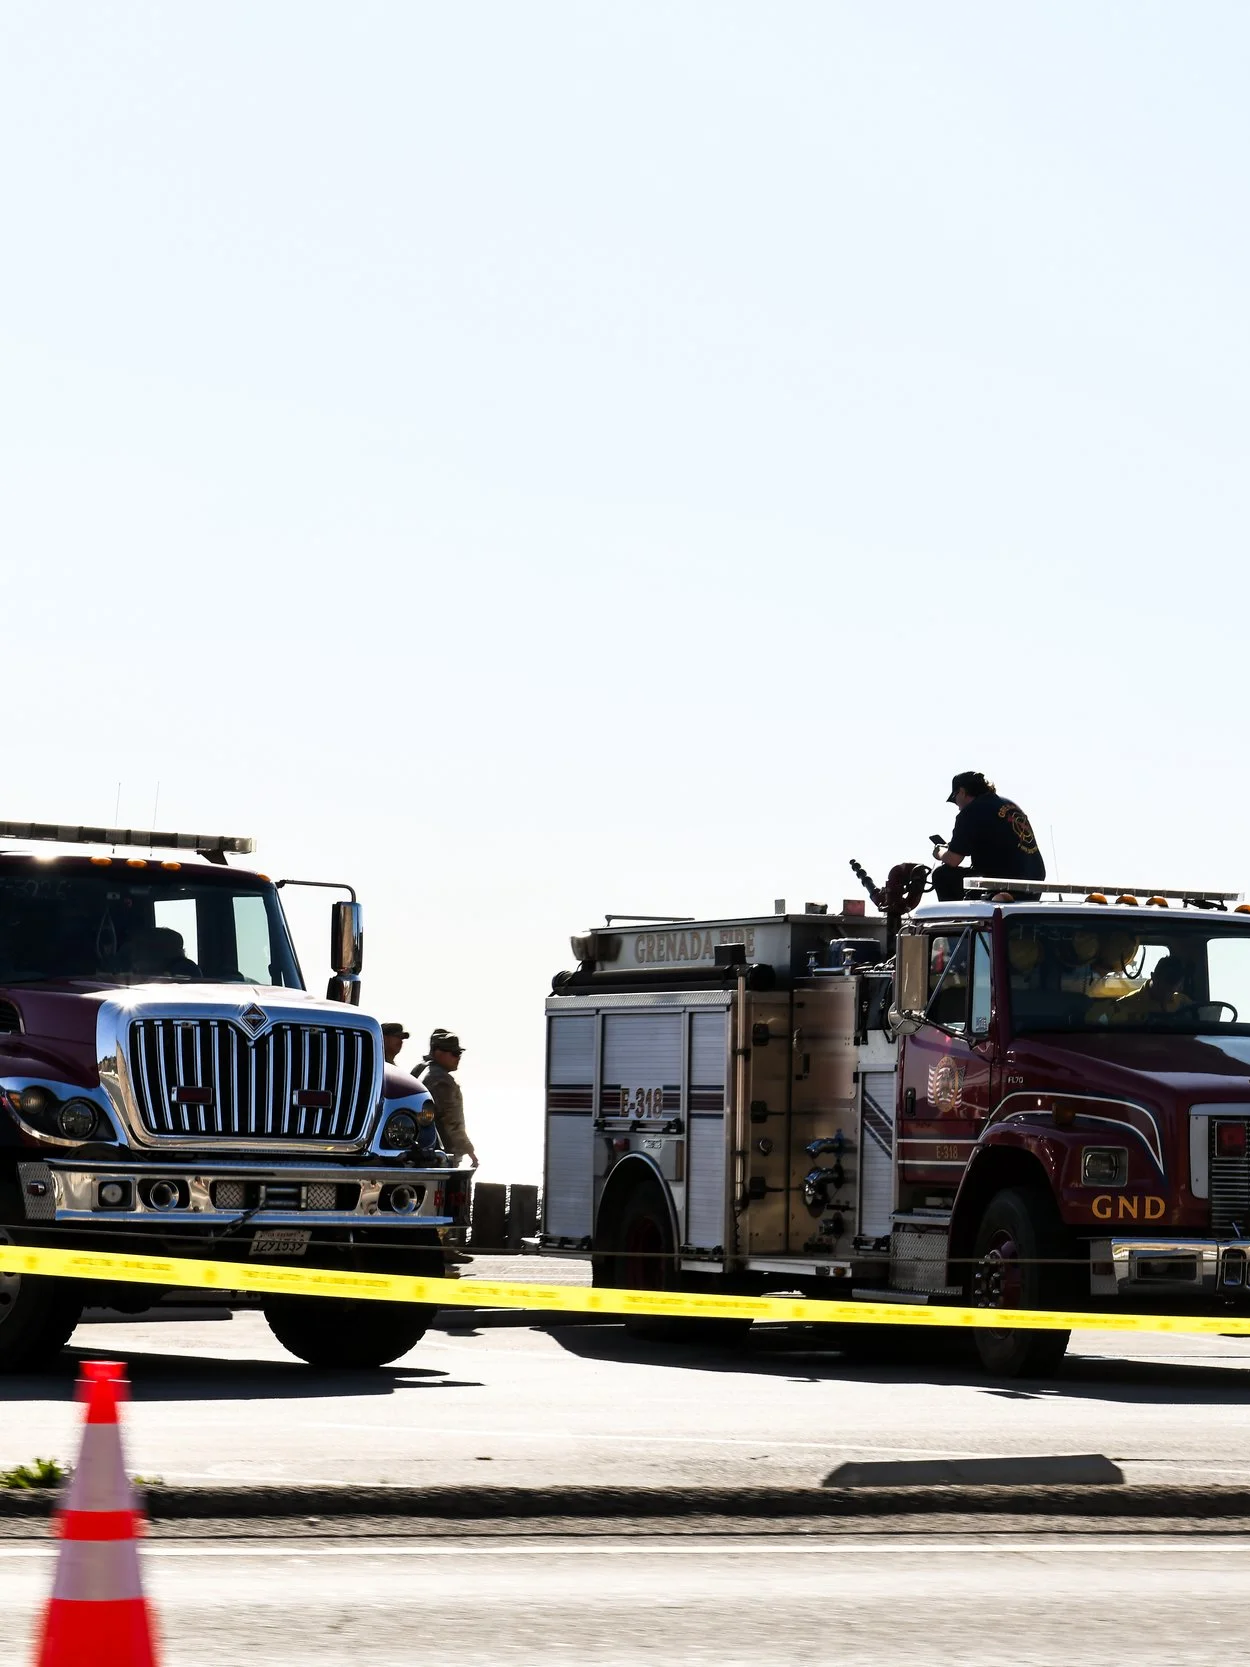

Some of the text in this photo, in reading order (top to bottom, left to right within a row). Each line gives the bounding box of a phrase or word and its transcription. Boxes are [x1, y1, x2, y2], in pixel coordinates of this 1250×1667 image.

[634, 931, 714, 963] GRENADA
[620, 1087, 663, 1118] E-318
[936, 1145, 958, 1159] E-318
[1092, 1194, 1166, 1219] GND
